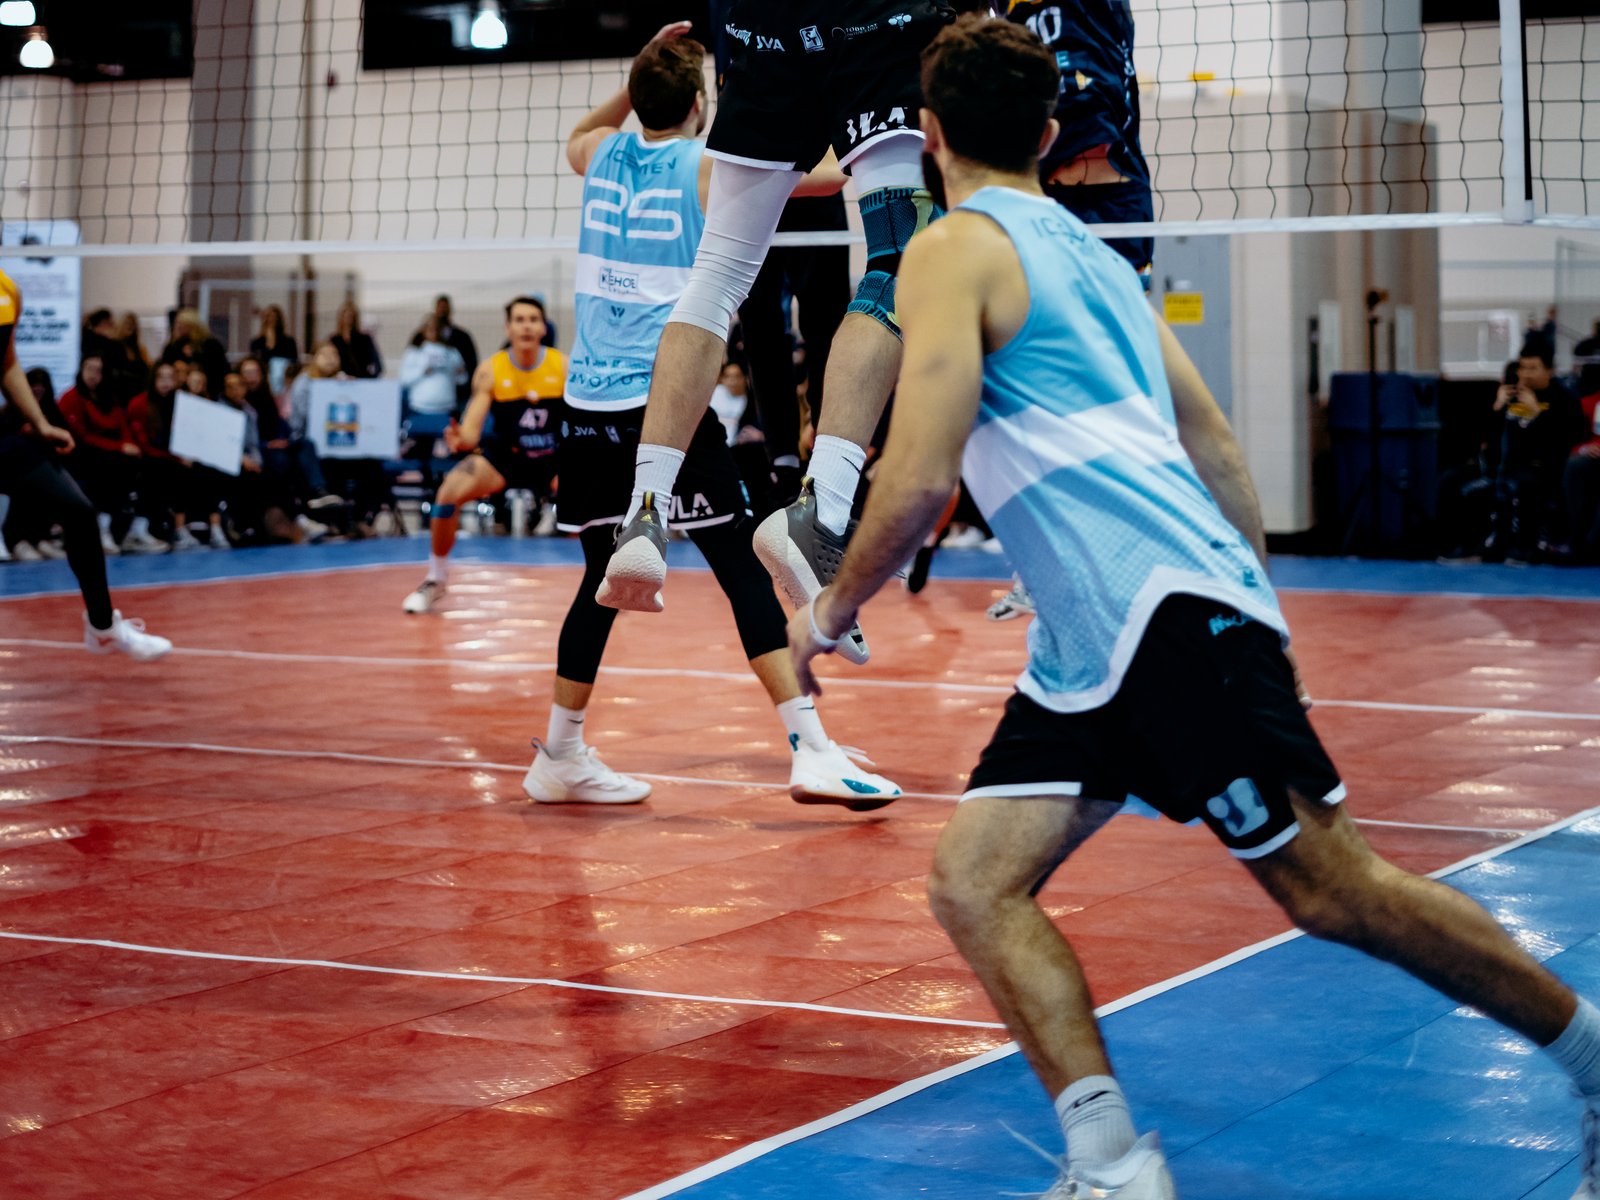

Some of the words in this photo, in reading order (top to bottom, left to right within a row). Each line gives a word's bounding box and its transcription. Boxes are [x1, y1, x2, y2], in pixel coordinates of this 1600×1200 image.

[756, 35, 786, 52] JVA
[584, 177, 683, 240] 25
[518, 407, 549, 430] 47
